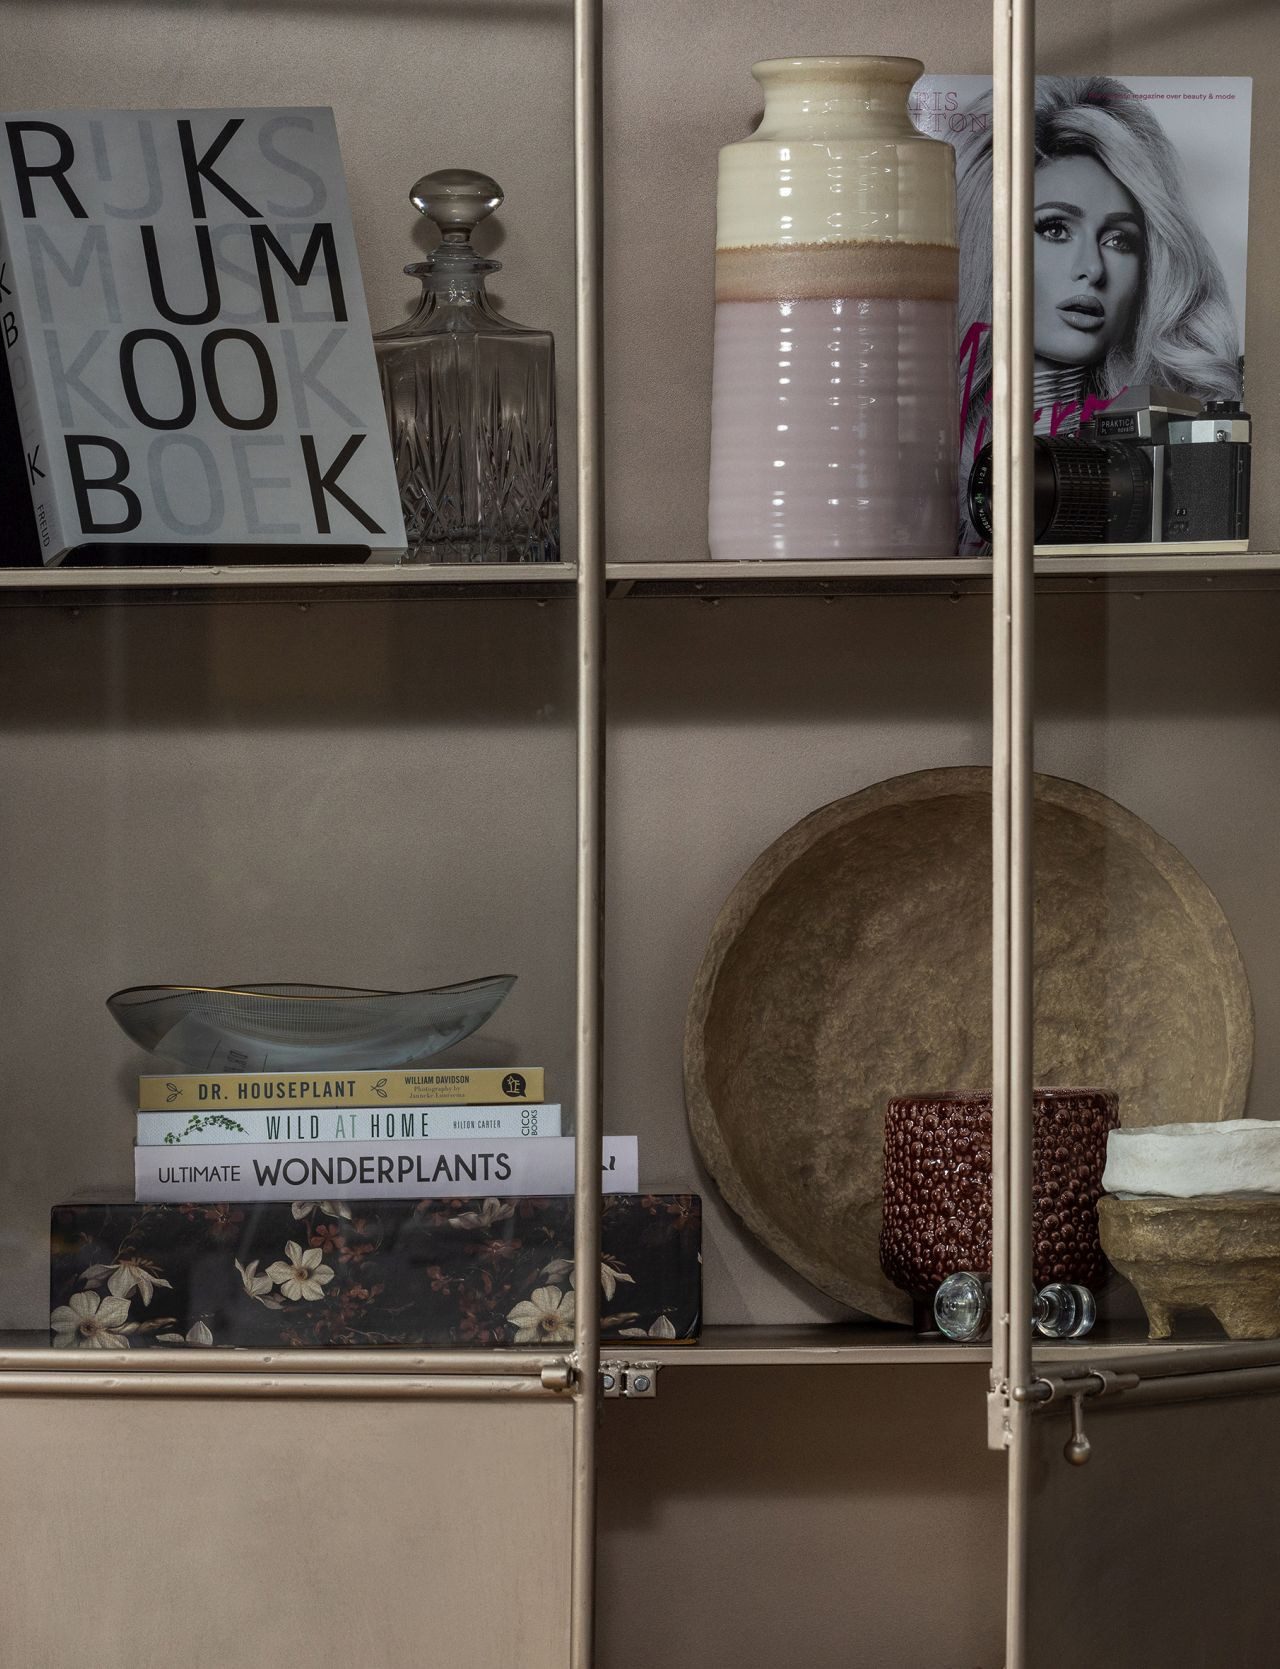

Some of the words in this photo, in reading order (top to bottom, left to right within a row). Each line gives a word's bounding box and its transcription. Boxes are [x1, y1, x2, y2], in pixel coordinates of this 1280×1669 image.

[1133, 93, 1164, 101] magazine
[1183, 92, 1206, 101] beauty
[43, 328, 369, 432] KOOK
[1101, 418, 1134, 428] PRAKTICA
[63, 433, 387, 535] BOEK
[36, 503, 51, 547] FREUD
[198, 1083, 228, 1100] DR.
[238, 1080, 356, 1099] HOUSEPLANT
[405, 1076, 434, 1085] WILLIAM
[435, 1075, 470, 1085] DAVIDSON
[413, 1085, 452, 1094] Photography
[266, 1115, 319, 1140] WILD
[335, 1114, 358, 1139] AT
[371, 1113, 429, 1138] HOME
[453, 1121, 474, 1130] HILTON
[477, 1119, 501, 1129] CARTER
[521, 1109, 530, 1136] CICO
[530, 1109, 538, 1136] BOOKS
[158, 1165, 241, 1184] ULTIMATE
[252, 1152, 512, 1187] WONDERPLANTS
